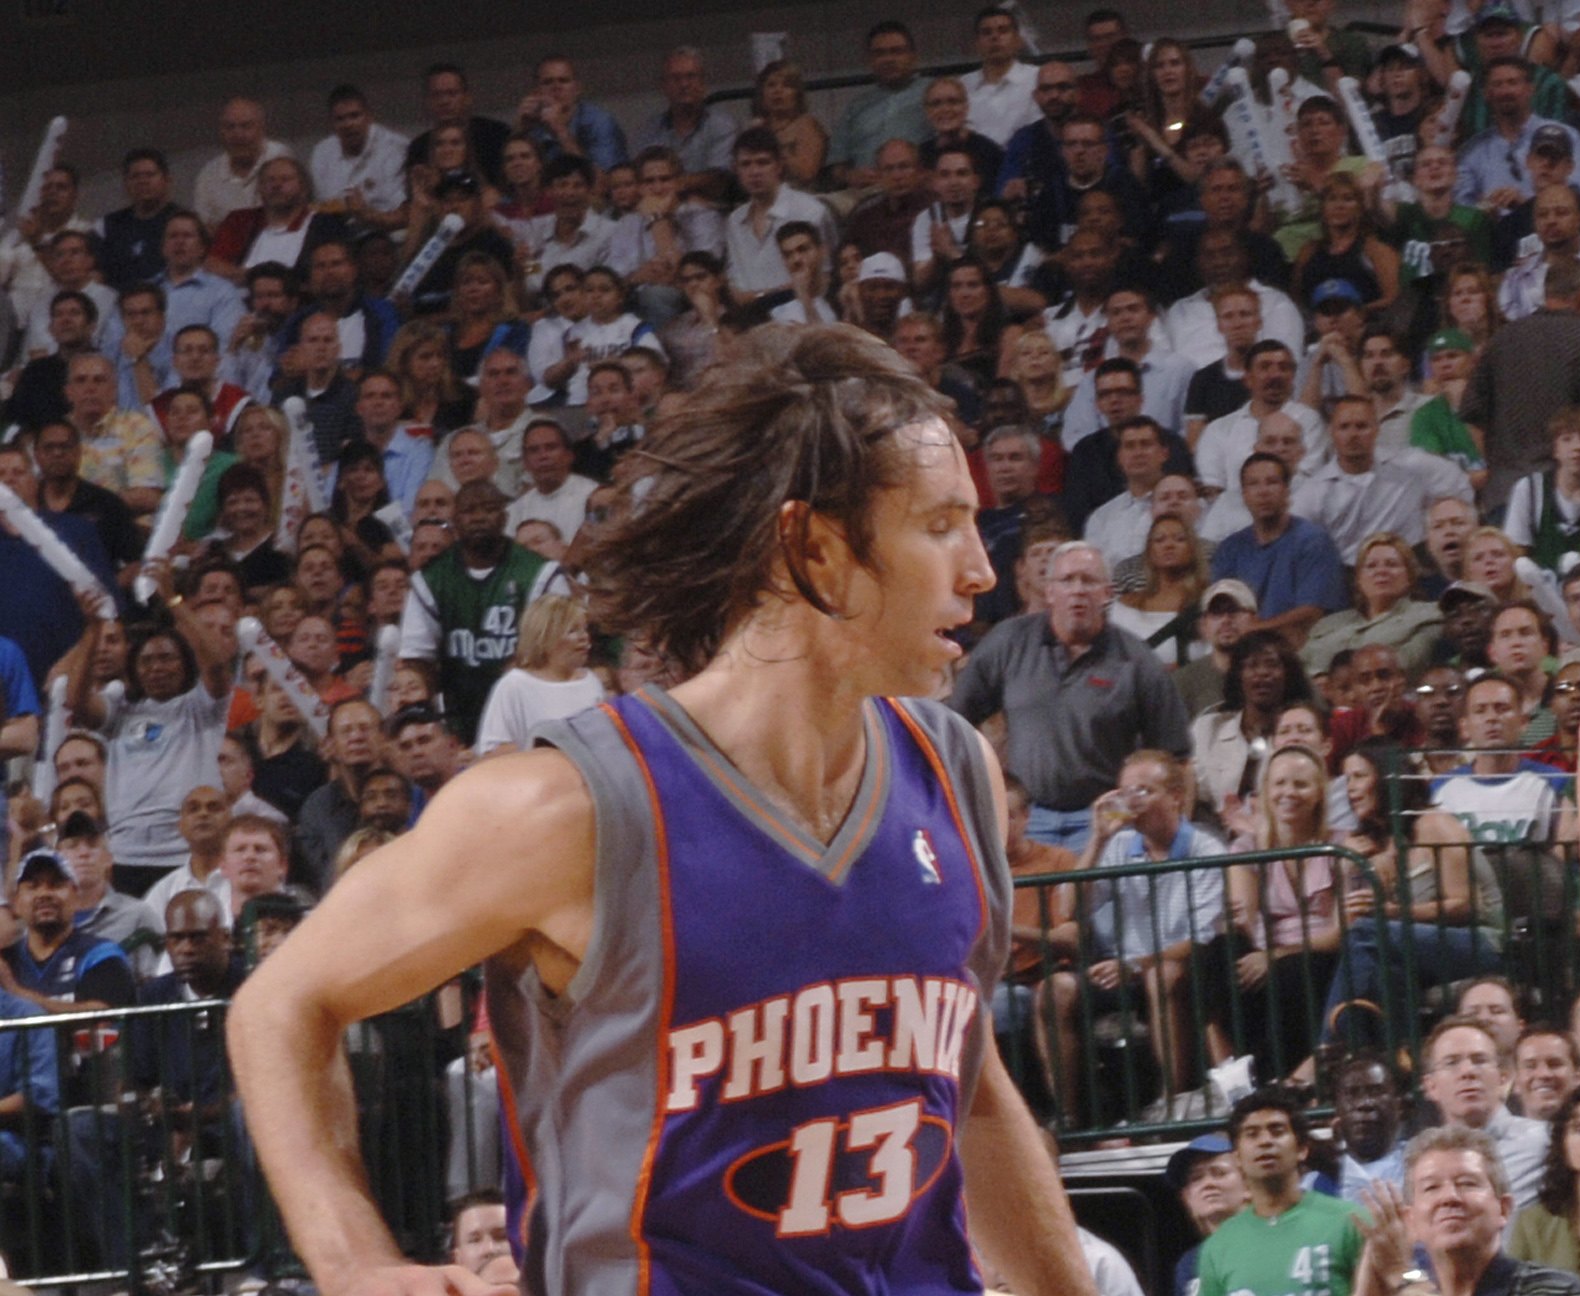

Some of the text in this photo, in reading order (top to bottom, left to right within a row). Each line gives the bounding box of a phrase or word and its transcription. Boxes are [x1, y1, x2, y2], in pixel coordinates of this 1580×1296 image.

[484, 605, 517, 635] 42
[664, 974, 977, 1112] PHOENIX
[775, 1096, 924, 1239] 13
